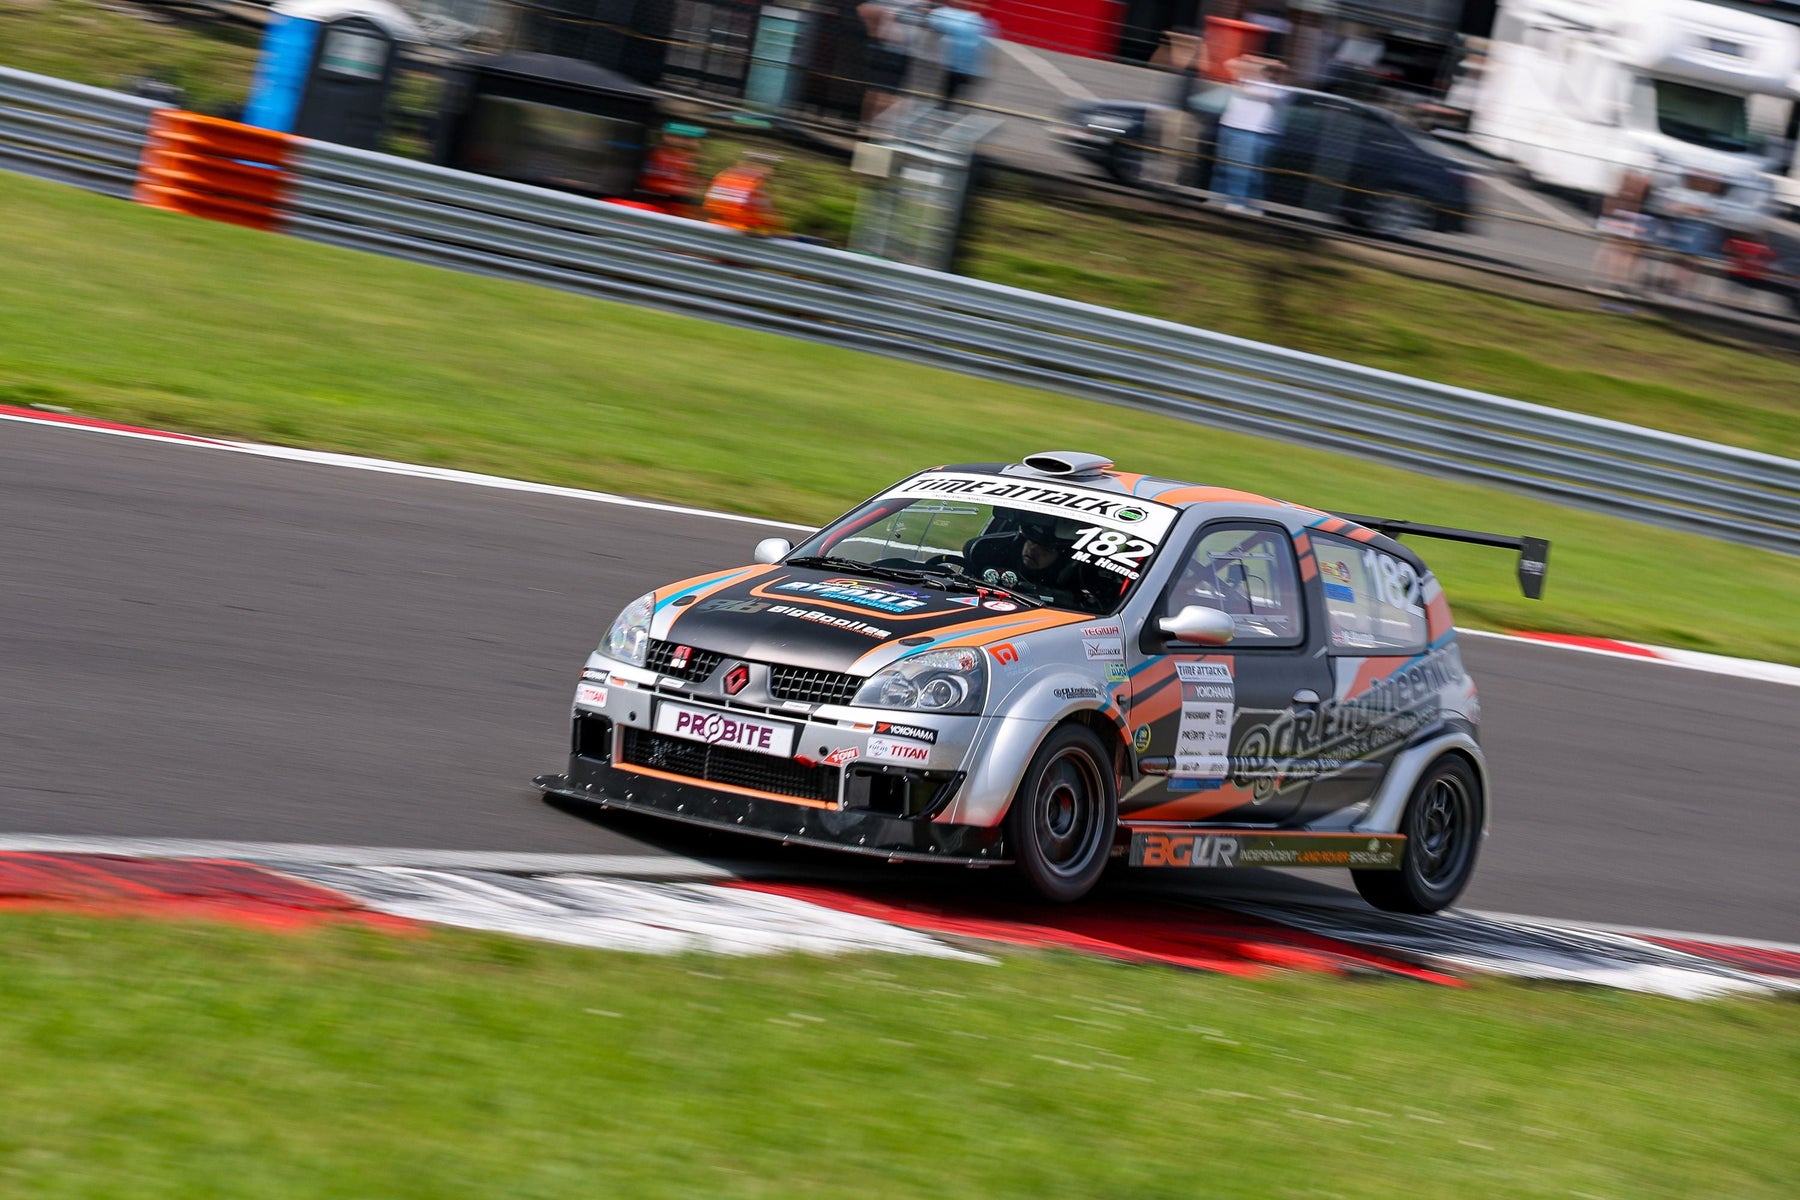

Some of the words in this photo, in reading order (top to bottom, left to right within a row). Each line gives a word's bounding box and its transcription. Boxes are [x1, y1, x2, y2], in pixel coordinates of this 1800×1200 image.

[985, 483, 1120, 515] ATTACK
[1071, 526, 1154, 568] 182
[1071, 550, 1092, 564] M.
[1094, 557, 1140, 580] Hume
[1362, 548, 1425, 619] 182
[890, 724, 935, 742] YOKOHAMA
[890, 744, 929, 761] TITAN
